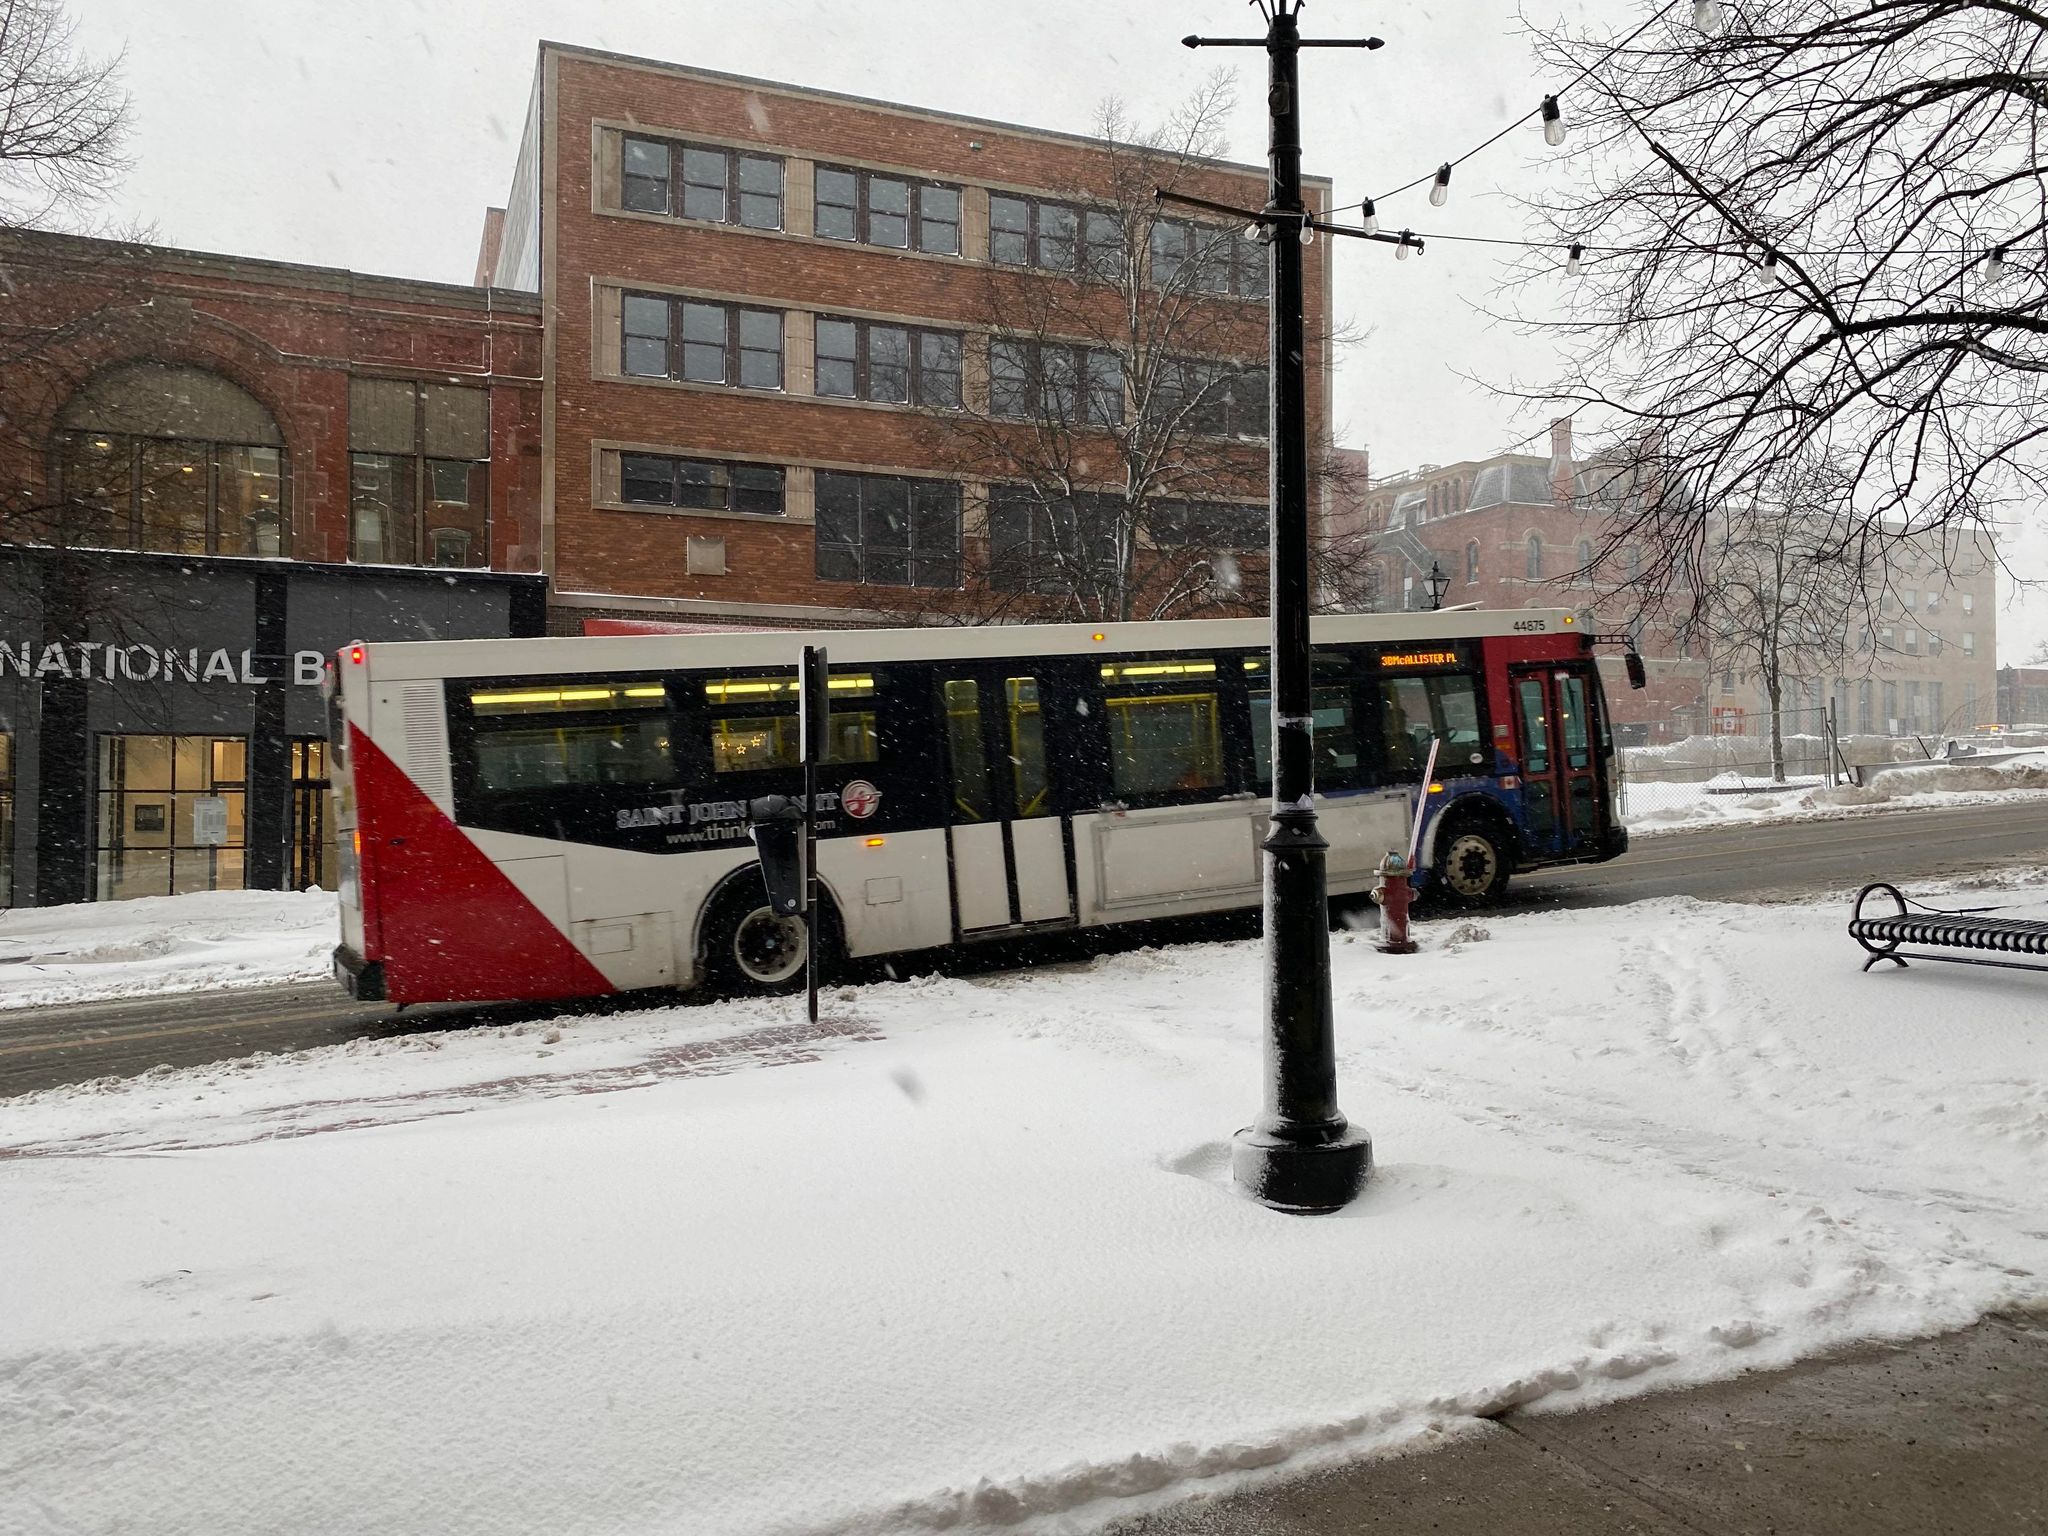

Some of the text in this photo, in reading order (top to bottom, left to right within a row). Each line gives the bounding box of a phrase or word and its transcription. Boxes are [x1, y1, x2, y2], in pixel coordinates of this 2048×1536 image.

[1513, 620, 1546, 632] 44875
[0, 640, 268, 685] NATIONAL
[1446, 652, 1458, 663] PL
[616, 799, 748, 829] SAINT JOHN
